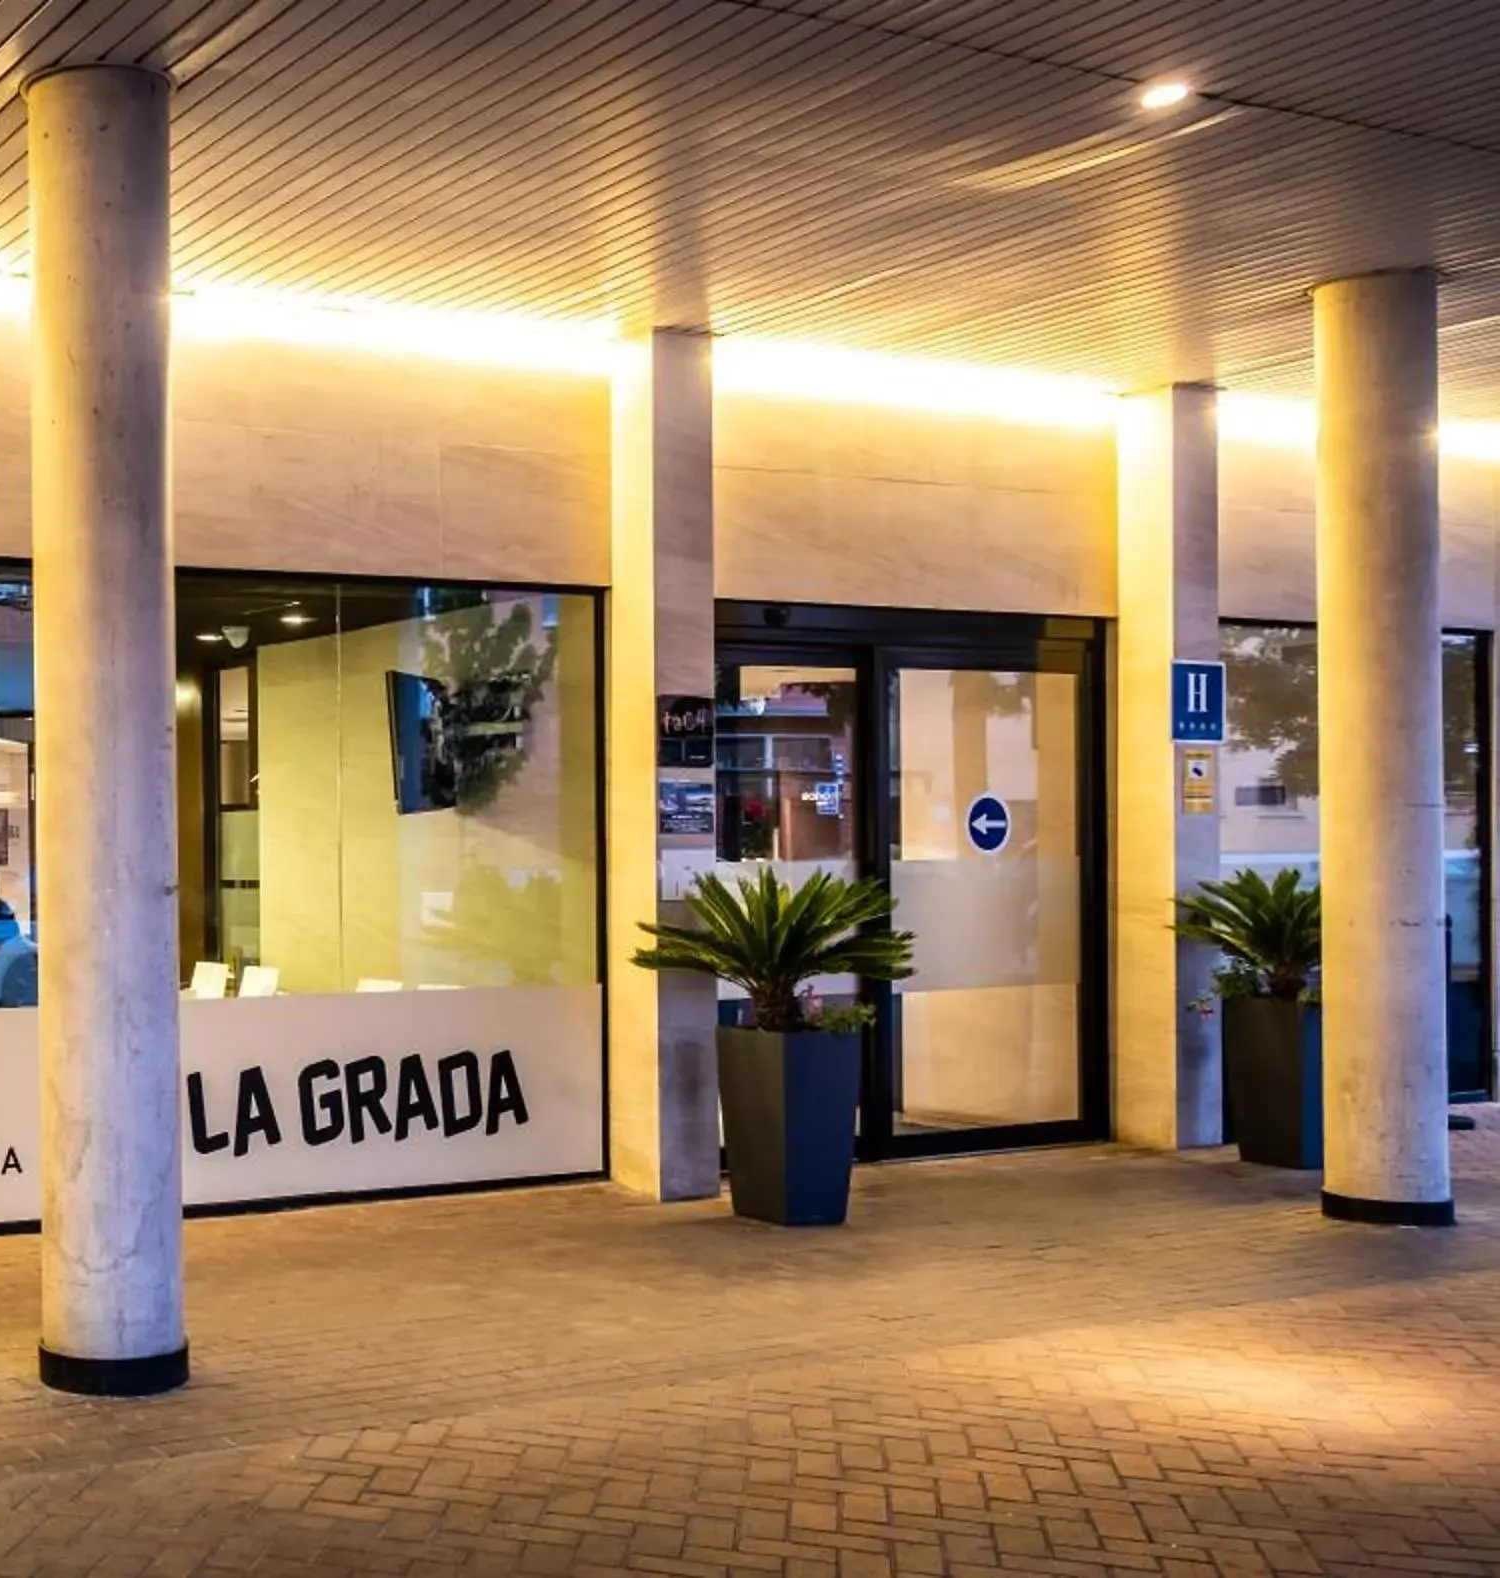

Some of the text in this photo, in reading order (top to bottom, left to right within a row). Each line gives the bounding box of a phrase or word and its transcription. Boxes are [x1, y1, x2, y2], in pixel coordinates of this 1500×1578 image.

[1187, 673, 1208, 712] H
[187, 1050, 529, 1157] LA GRADA
